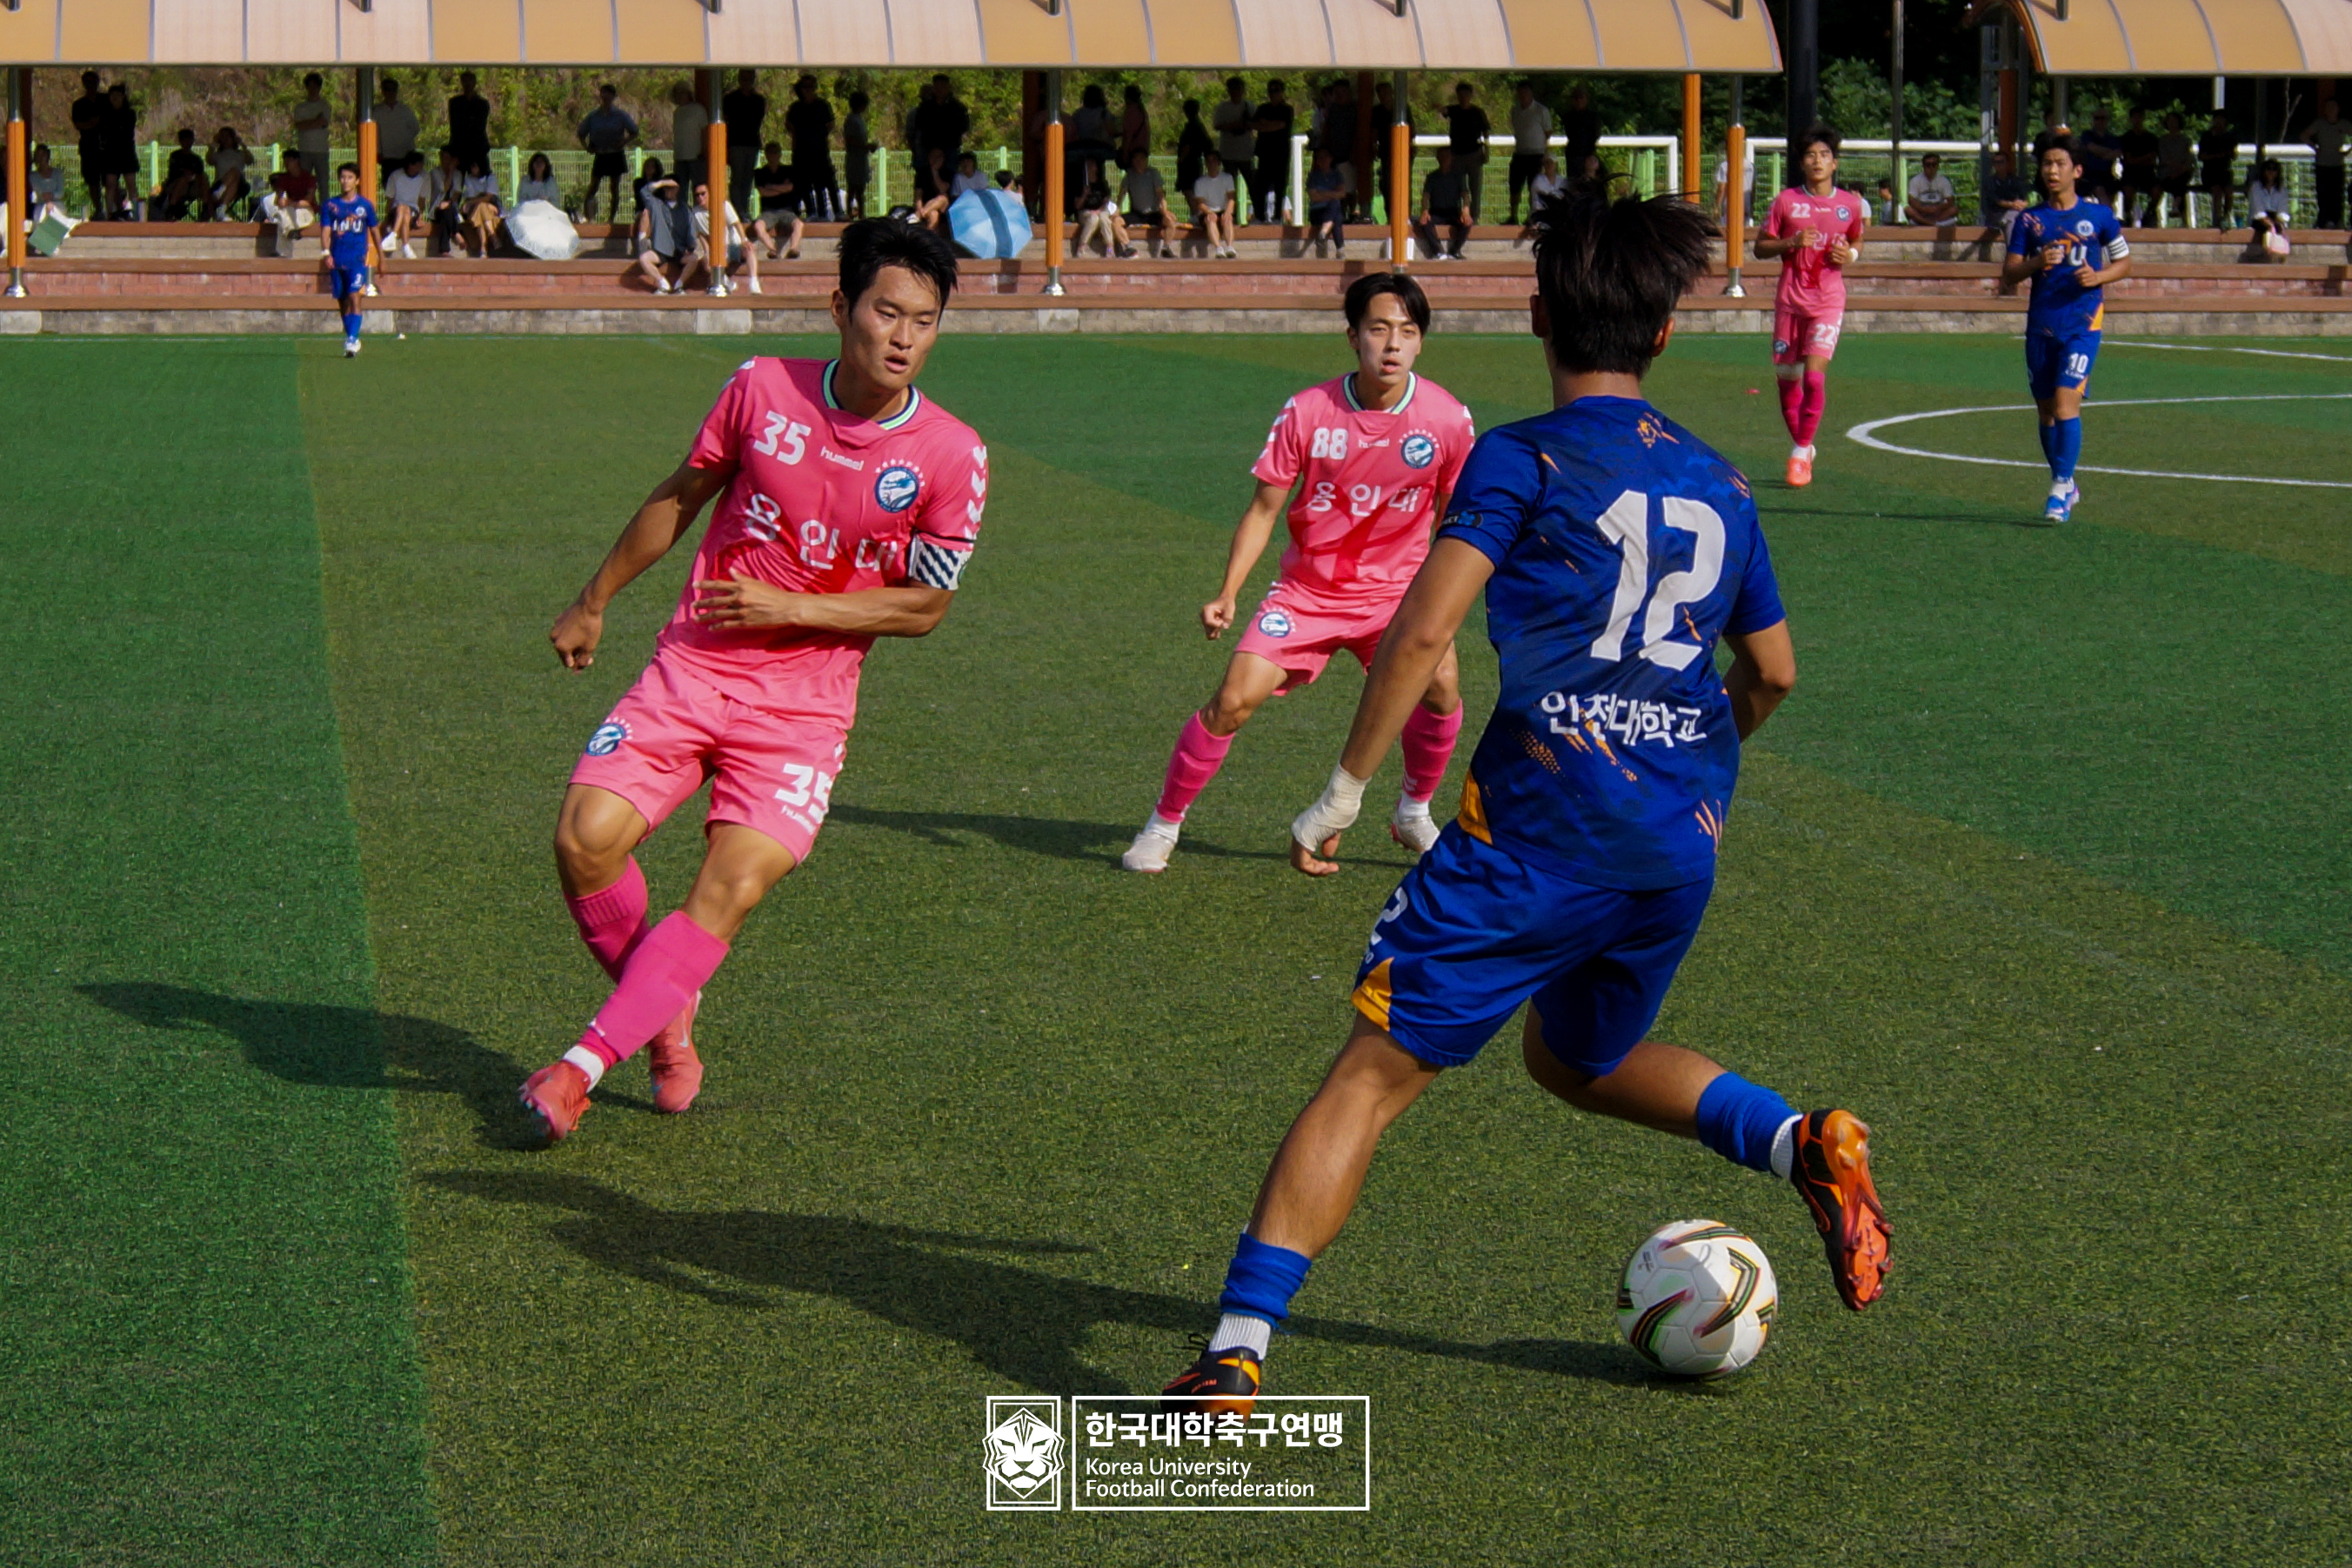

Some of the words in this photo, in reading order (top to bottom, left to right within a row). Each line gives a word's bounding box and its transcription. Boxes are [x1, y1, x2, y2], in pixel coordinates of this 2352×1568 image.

[1791, 202, 1811, 218] 22
[333, 220, 362, 232] INU
[1814, 323, 1836, 345] 22
[2070, 352, 2088, 374] 10
[753, 410, 812, 466] 35
[1311, 427, 1349, 460] 88
[1591, 489, 1727, 672] 12
[774, 763, 833, 824] 35
